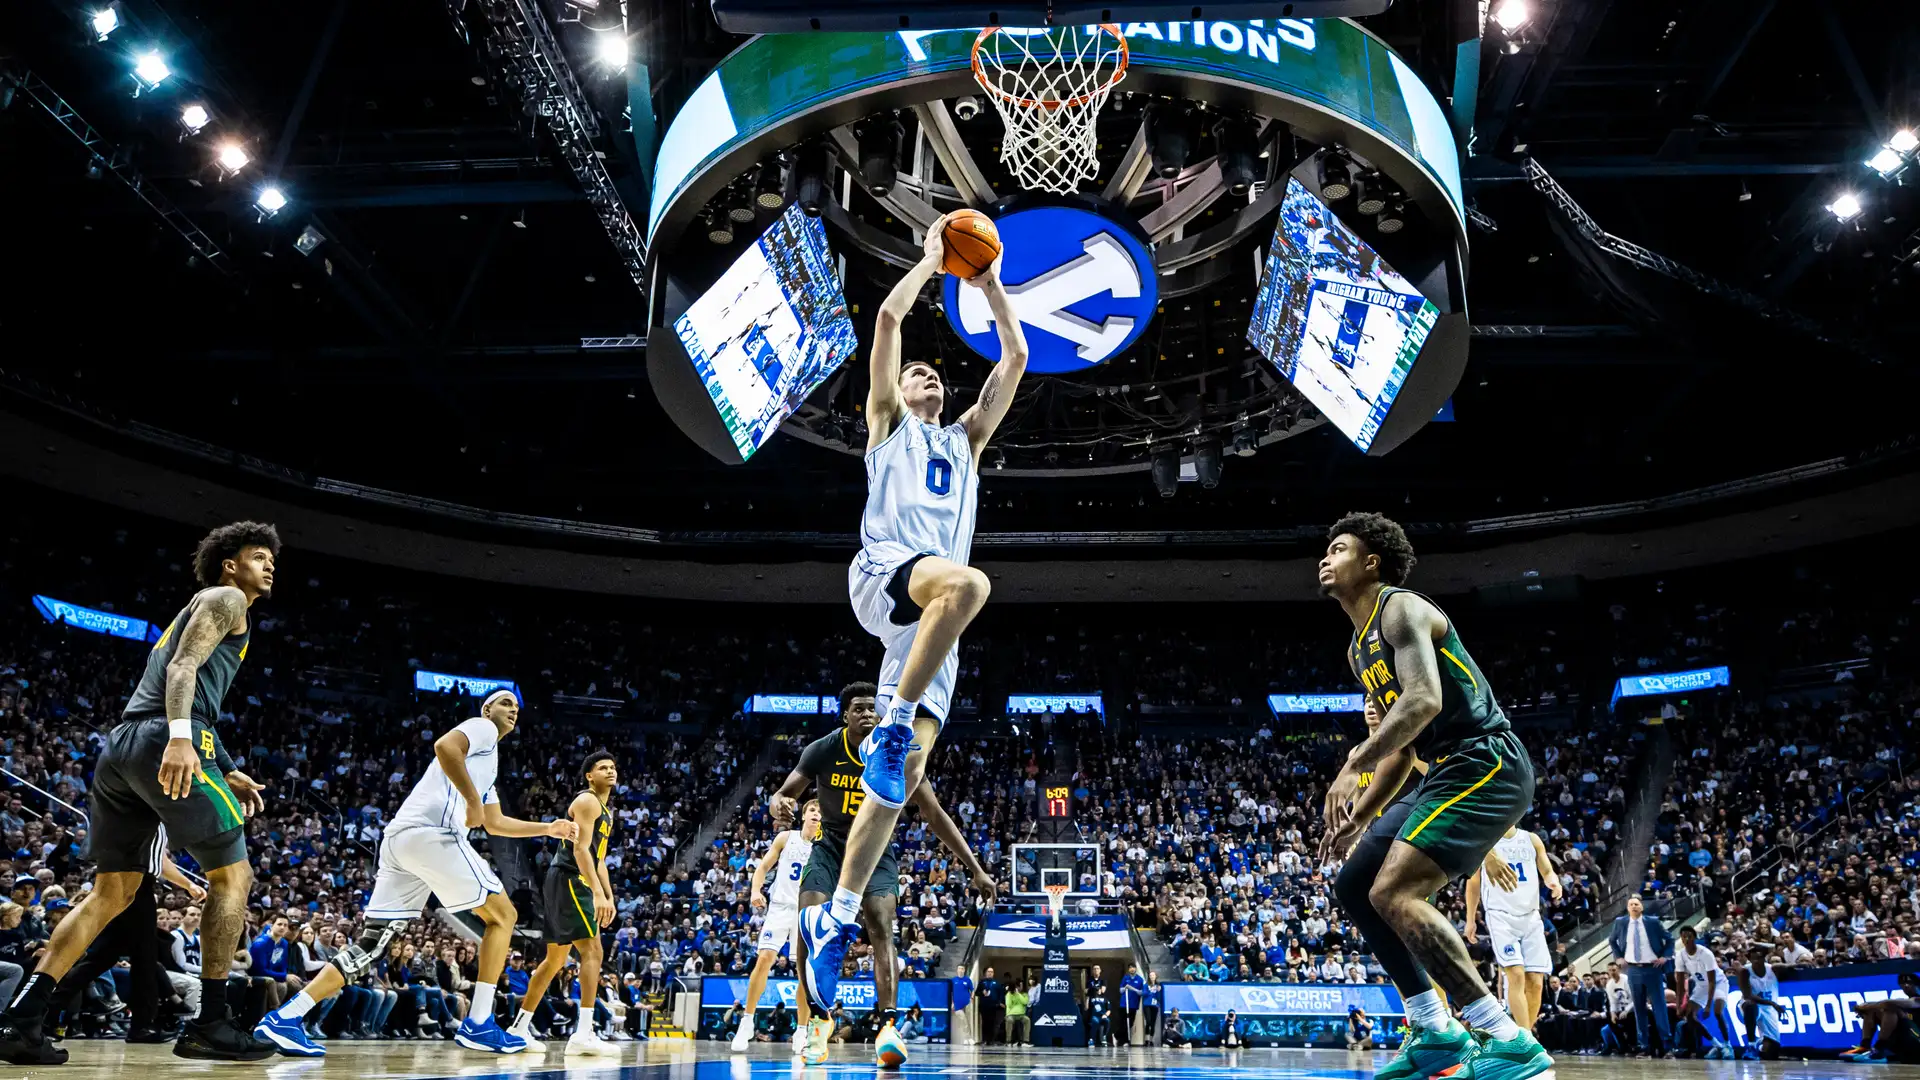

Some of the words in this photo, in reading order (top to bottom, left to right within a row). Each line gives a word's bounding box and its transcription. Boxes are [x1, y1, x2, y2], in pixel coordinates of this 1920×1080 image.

[1366, 289, 1407, 310] YOUNG
[926, 457, 953, 496] 0
[77, 610, 129, 630] SPORTS
[84, 619, 119, 632] NATION
[1663, 671, 1712, 685] SPORTS
[1672, 679, 1705, 689] NATION
[1045, 698, 1086, 707] SPORTS
[1306, 697, 1349, 705] SPORTS
[1046, 787, 1069, 799] 6:09
[842, 791, 866, 817] 15
[1050, 799, 1067, 817] 17
[1273, 989, 1343, 1003] SPORTS
[1286, 1000, 1332, 1010] NATION
